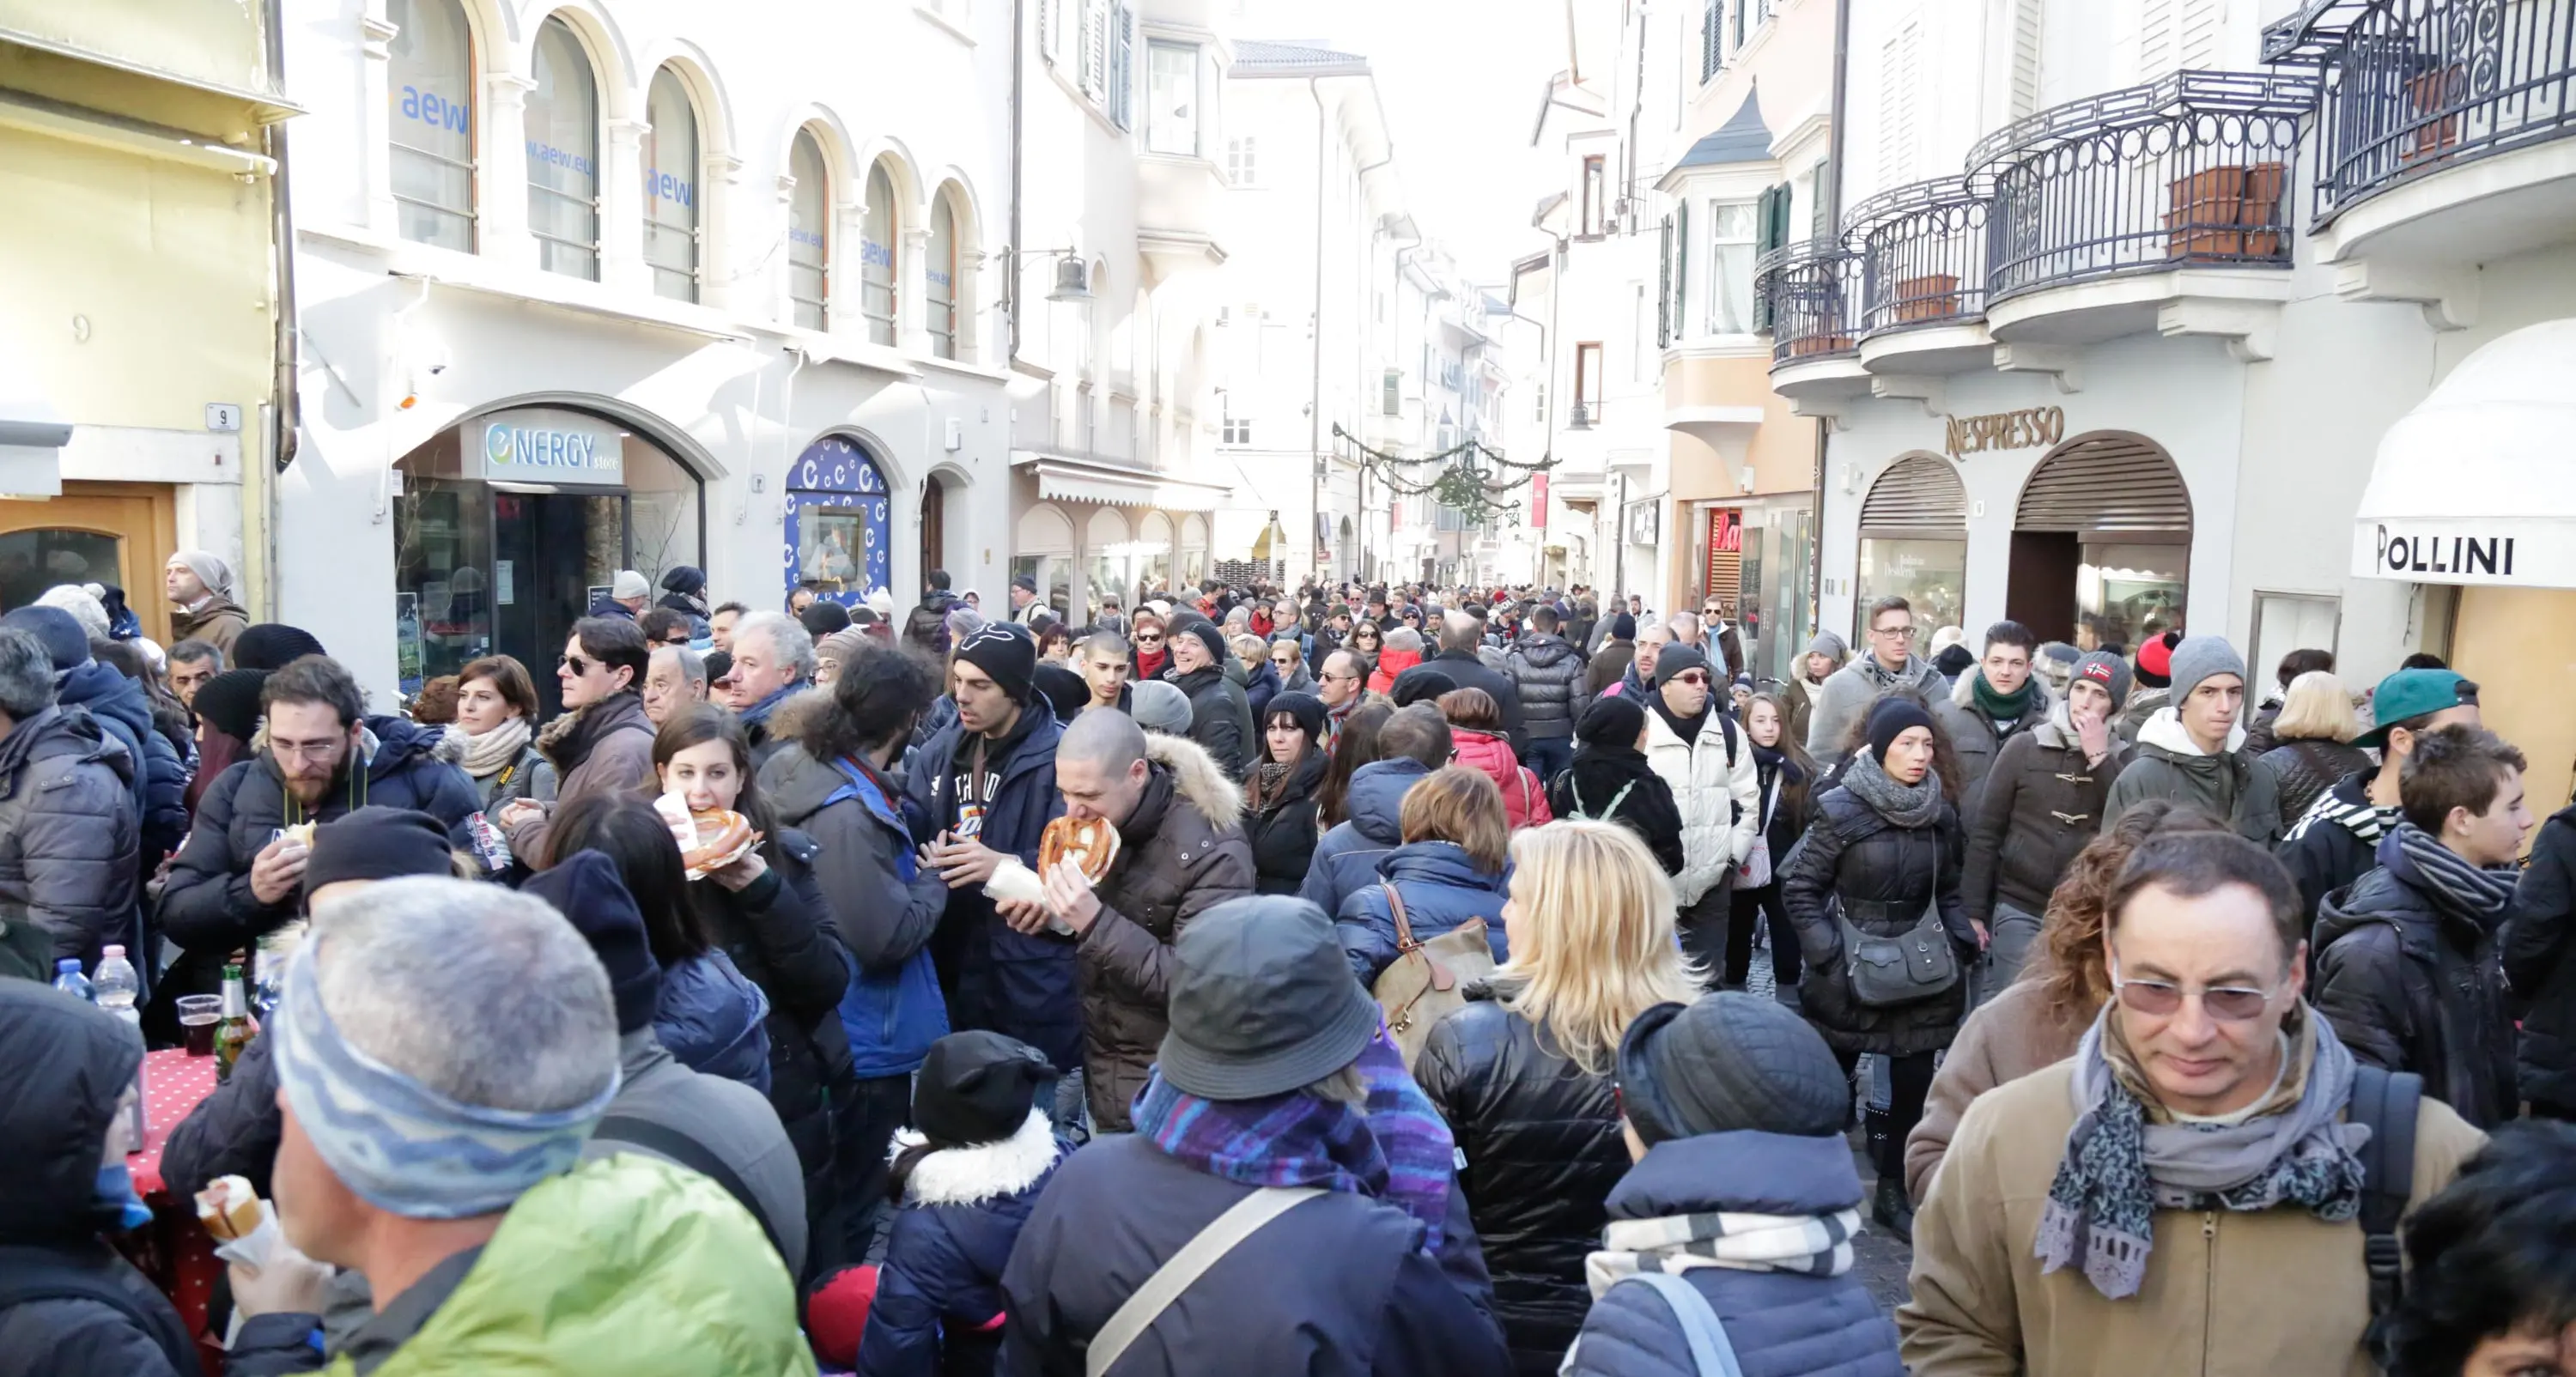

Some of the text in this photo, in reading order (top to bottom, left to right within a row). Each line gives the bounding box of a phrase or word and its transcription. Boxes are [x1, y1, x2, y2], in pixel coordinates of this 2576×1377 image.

[402, 85, 468, 135] aew
[647, 169, 692, 206] aew
[219, 409, 228, 426] 9
[2377, 524, 2515, 576] POLLINI
